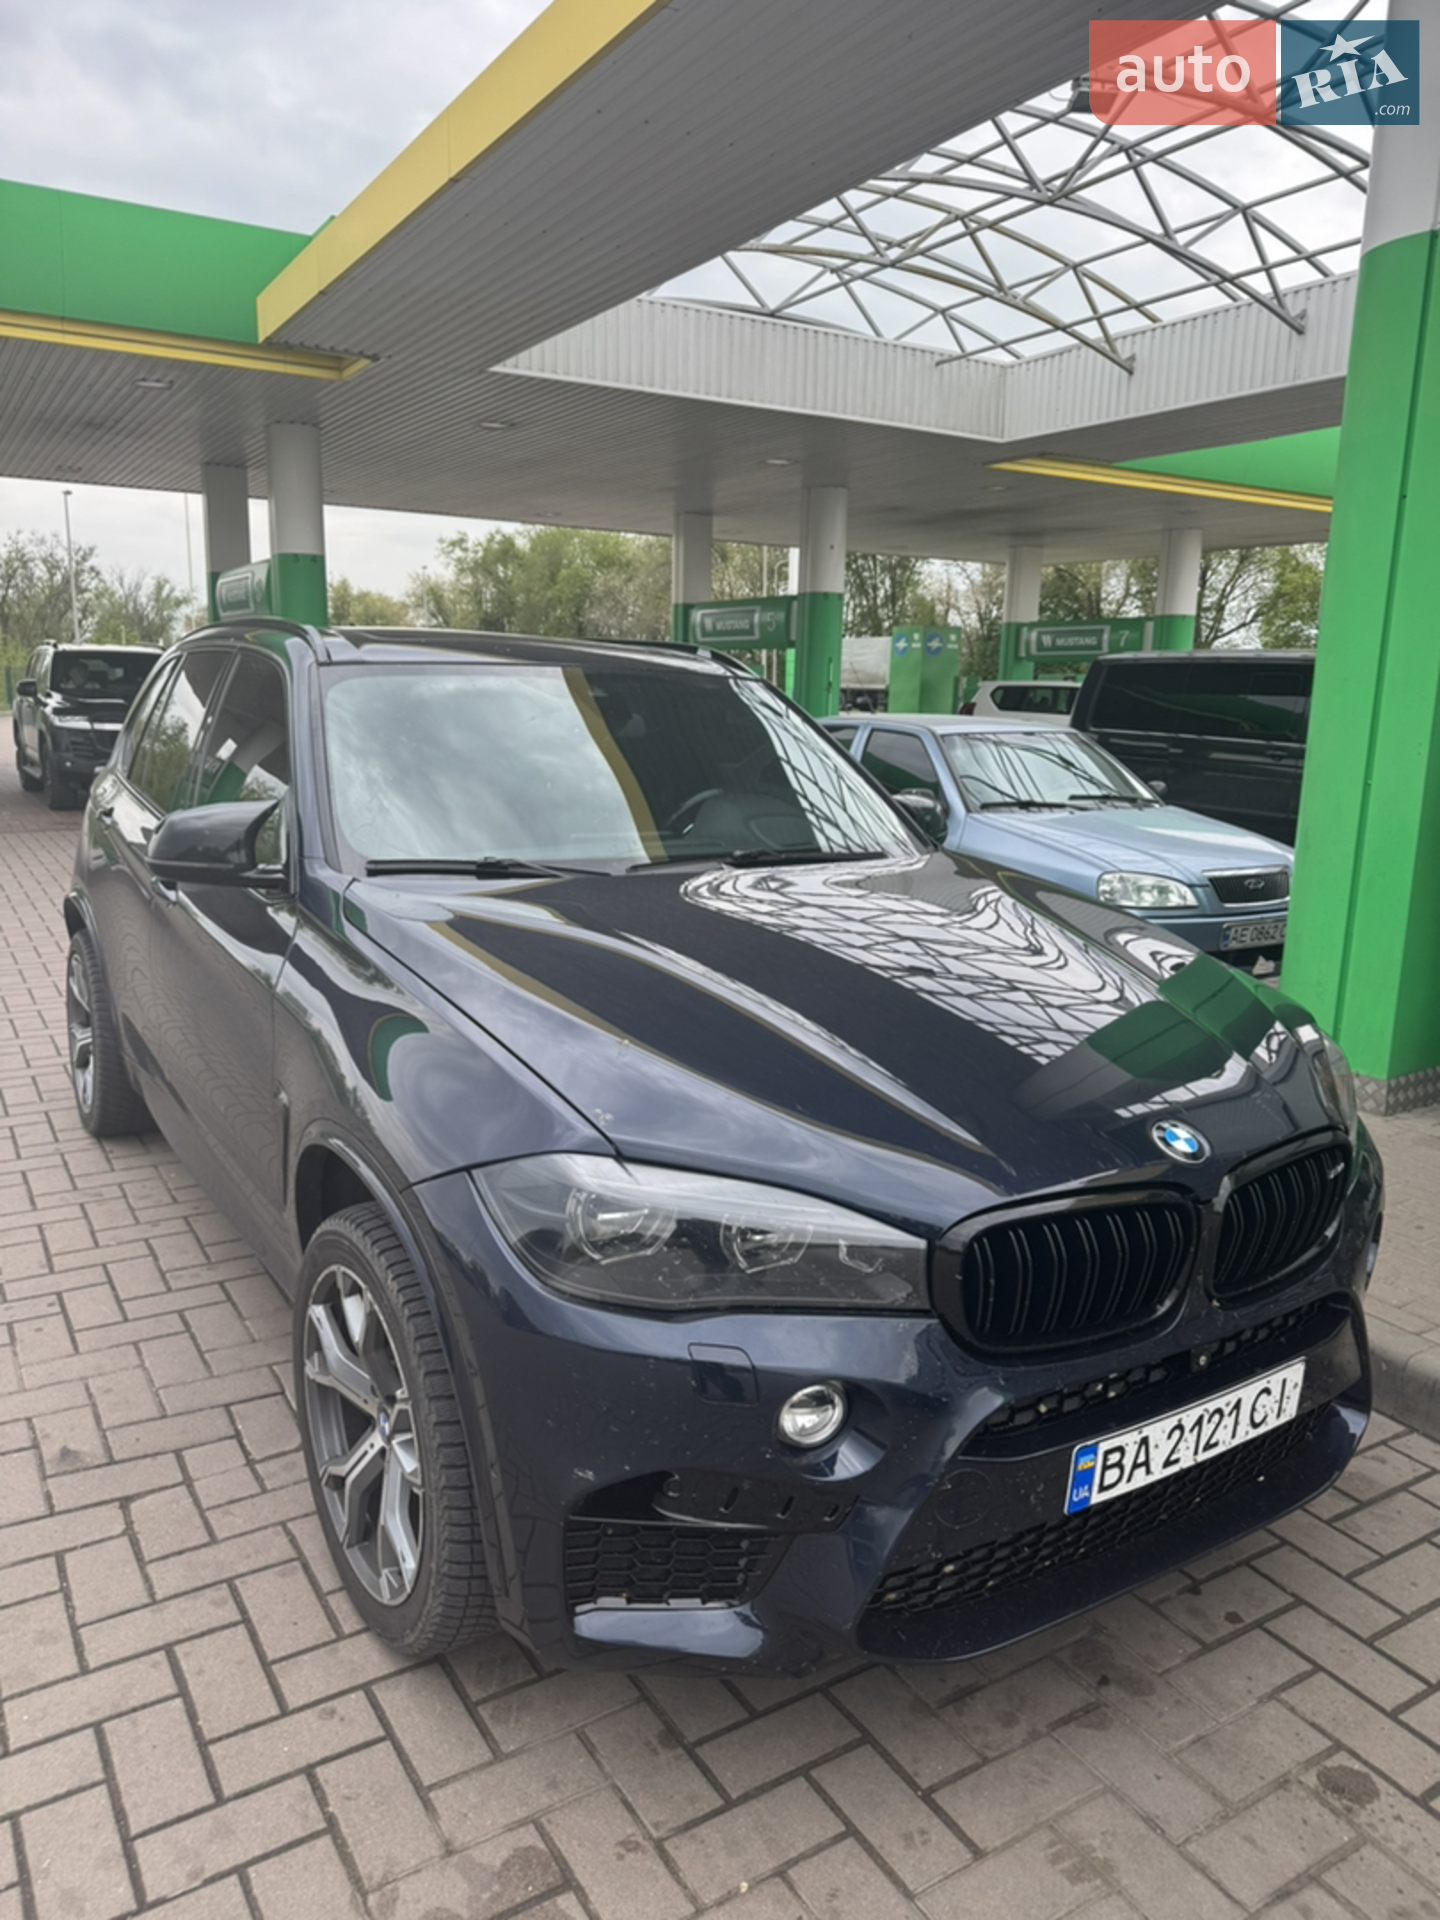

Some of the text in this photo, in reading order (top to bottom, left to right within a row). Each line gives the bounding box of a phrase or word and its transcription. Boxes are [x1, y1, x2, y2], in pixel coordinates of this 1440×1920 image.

[716, 619, 750, 631] MUSTANG
[767, 611, 776, 632] 5
[1056, 636, 1097, 646] MUSTANG
[1119, 630, 1130, 647] 7
[1230, 926, 1249, 945] AE
[1250, 924, 1279, 943] 0862
[1097, 1377, 1288, 1494] BA 2121 CI
[1072, 1484, 1091, 1502] UA
